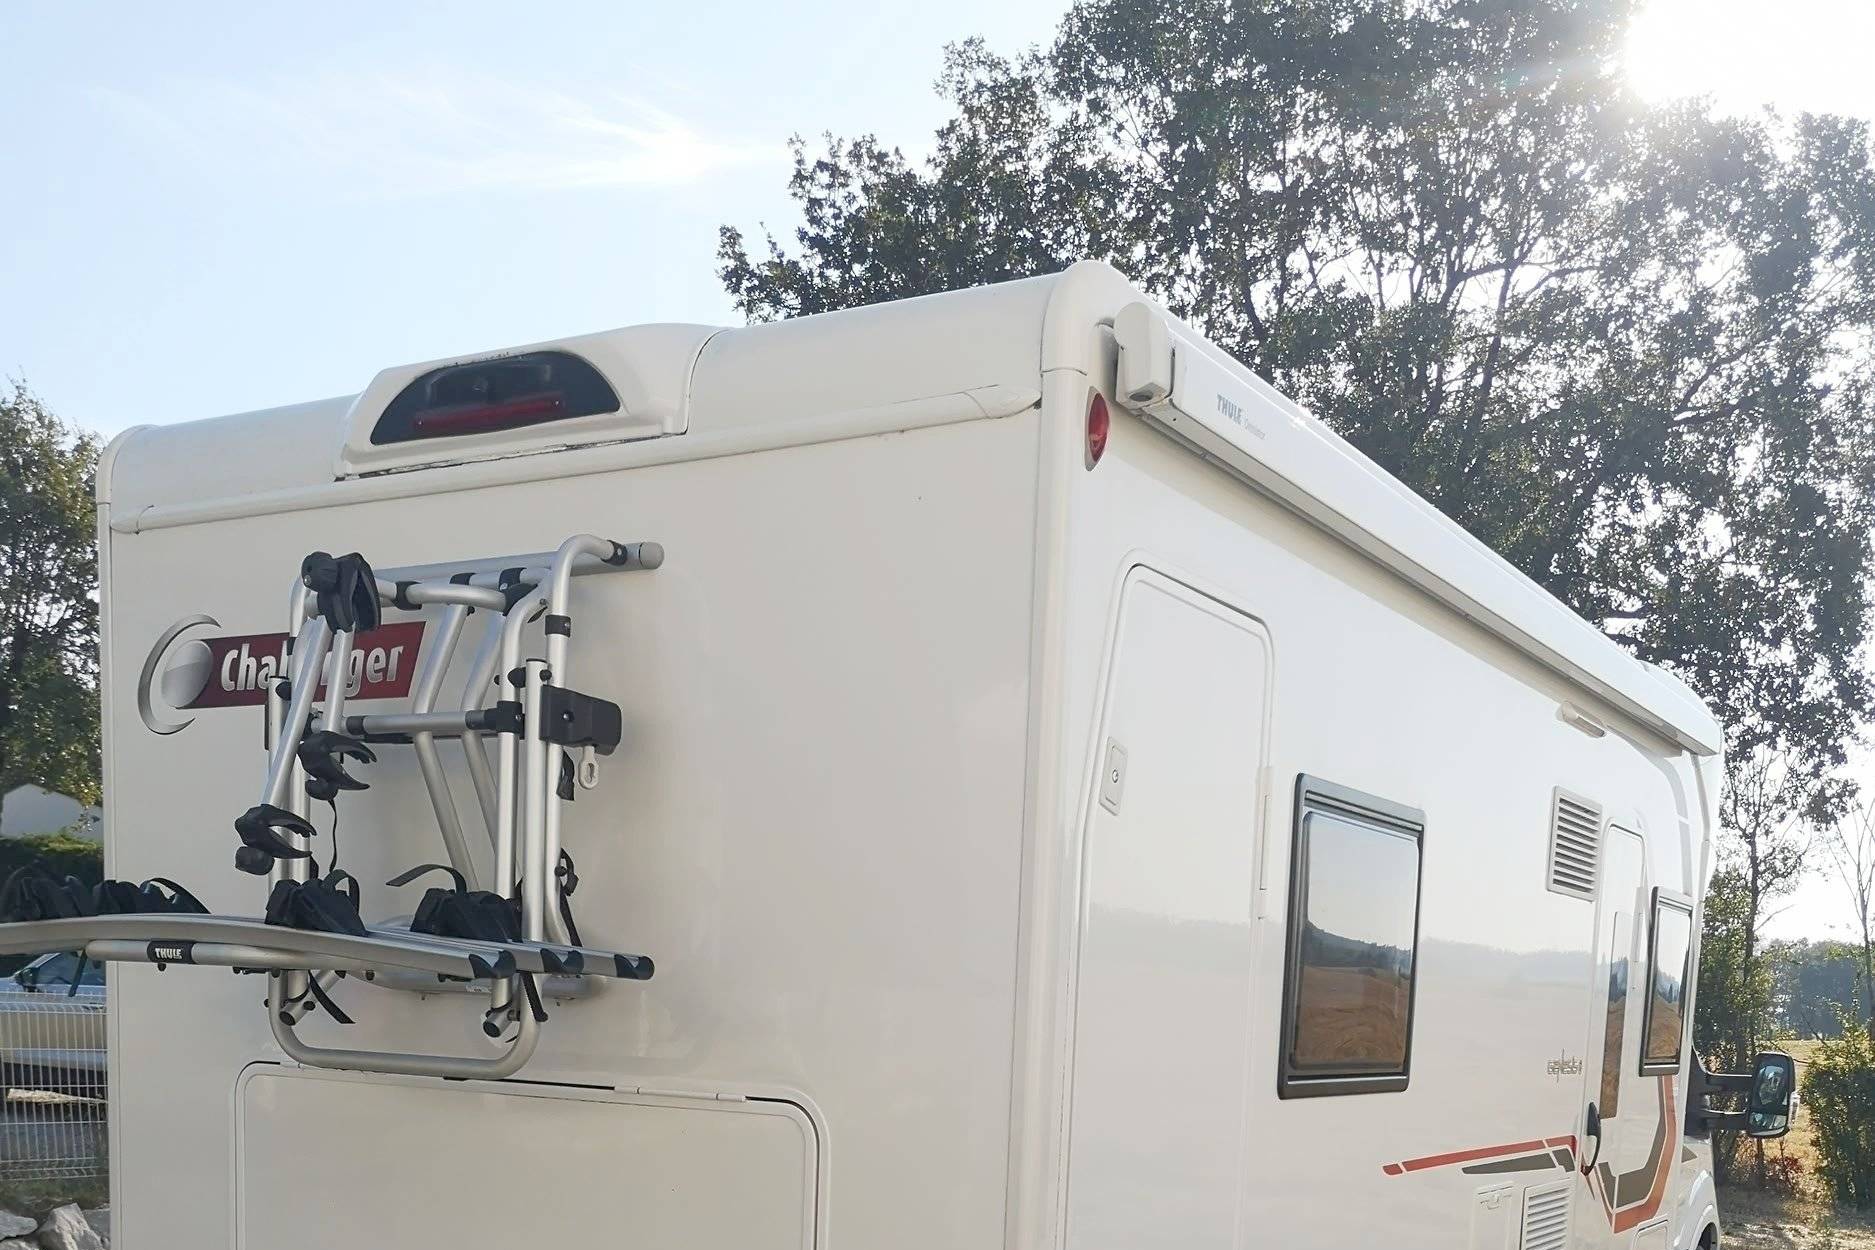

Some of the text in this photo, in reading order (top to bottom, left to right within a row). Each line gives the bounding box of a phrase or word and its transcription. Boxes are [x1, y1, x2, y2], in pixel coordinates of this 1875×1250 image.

[1216, 393, 1243, 425] THULE
[220, 640, 404, 697] Chalger
[154, 947, 183, 960] THULE
